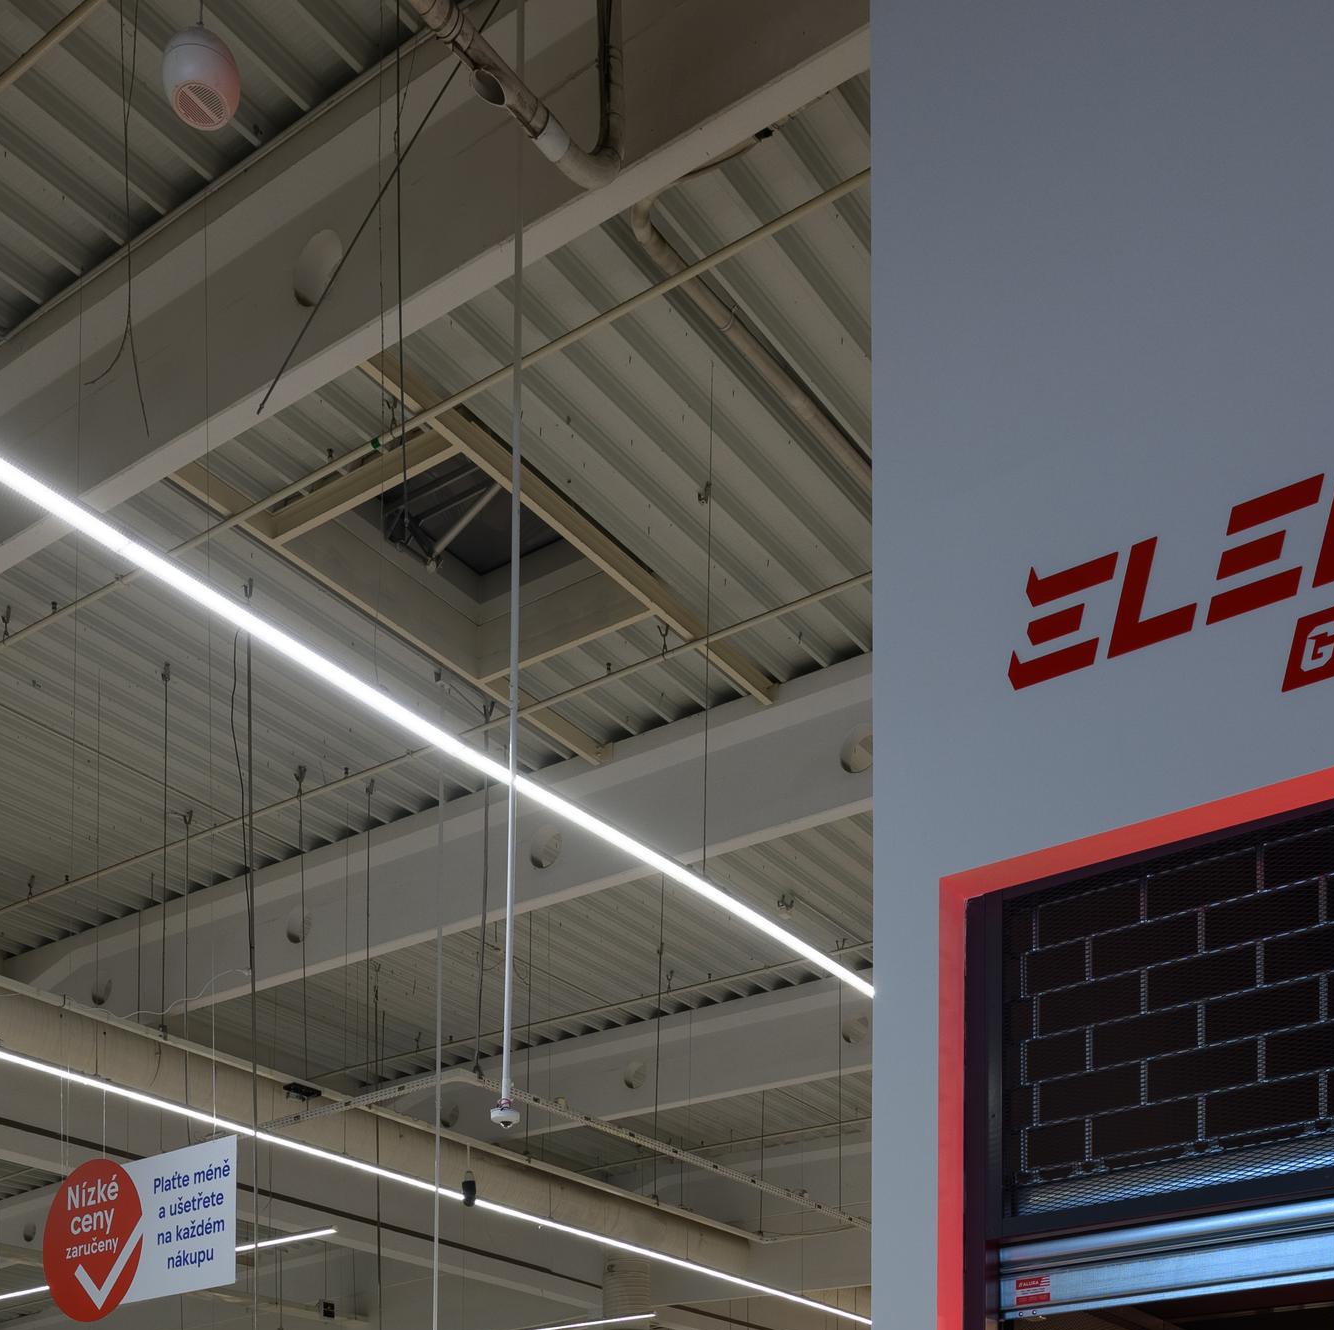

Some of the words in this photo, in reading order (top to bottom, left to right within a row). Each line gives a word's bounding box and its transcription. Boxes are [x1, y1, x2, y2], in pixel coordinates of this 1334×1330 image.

[153, 1171, 190, 1195] Plaťte
[193, 1159, 231, 1187] méně
[67, 1174, 120, 1211] Nízké
[158, 1207, 166, 1219] a
[169, 1190, 224, 1216] ušetřete
[70, 1207, 115, 1238] ceny
[157, 1230, 173, 1245] na
[175, 1216, 225, 1242] každém
[65, 1235, 119, 1260] zaručeny
[167, 1245, 214, 1270] nákupu
